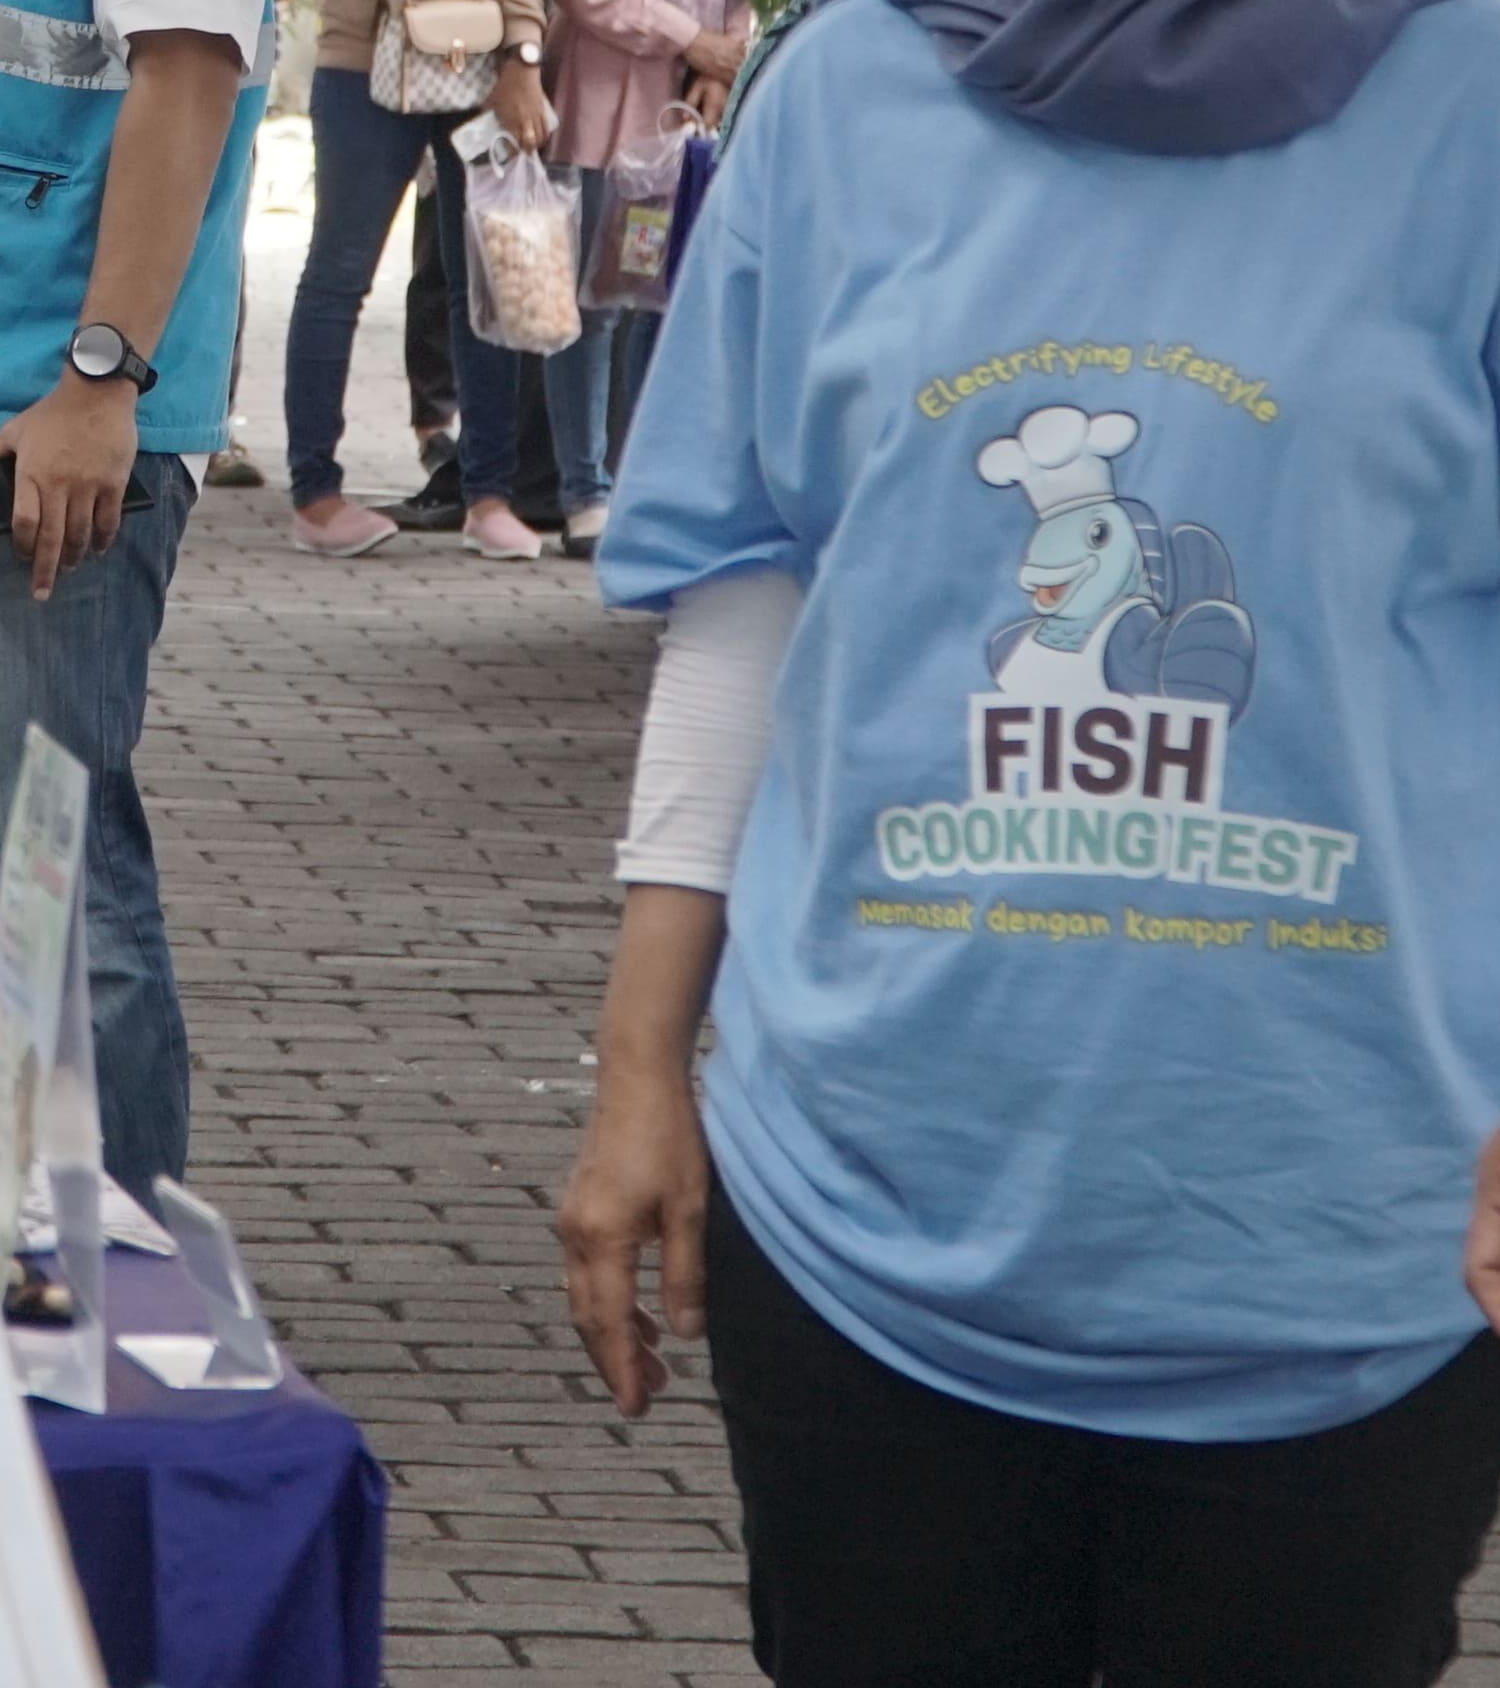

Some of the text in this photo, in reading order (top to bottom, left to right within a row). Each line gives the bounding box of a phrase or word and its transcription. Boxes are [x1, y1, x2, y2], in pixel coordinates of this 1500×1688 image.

[917, 339, 1279, 422] Electrifying Lifestyle
[984, 706, 1212, 804] FISH
[884, 808, 1346, 894] COOKING FEST
[857, 897, 974, 931] Memasak
[986, 899, 1111, 943] dengan
